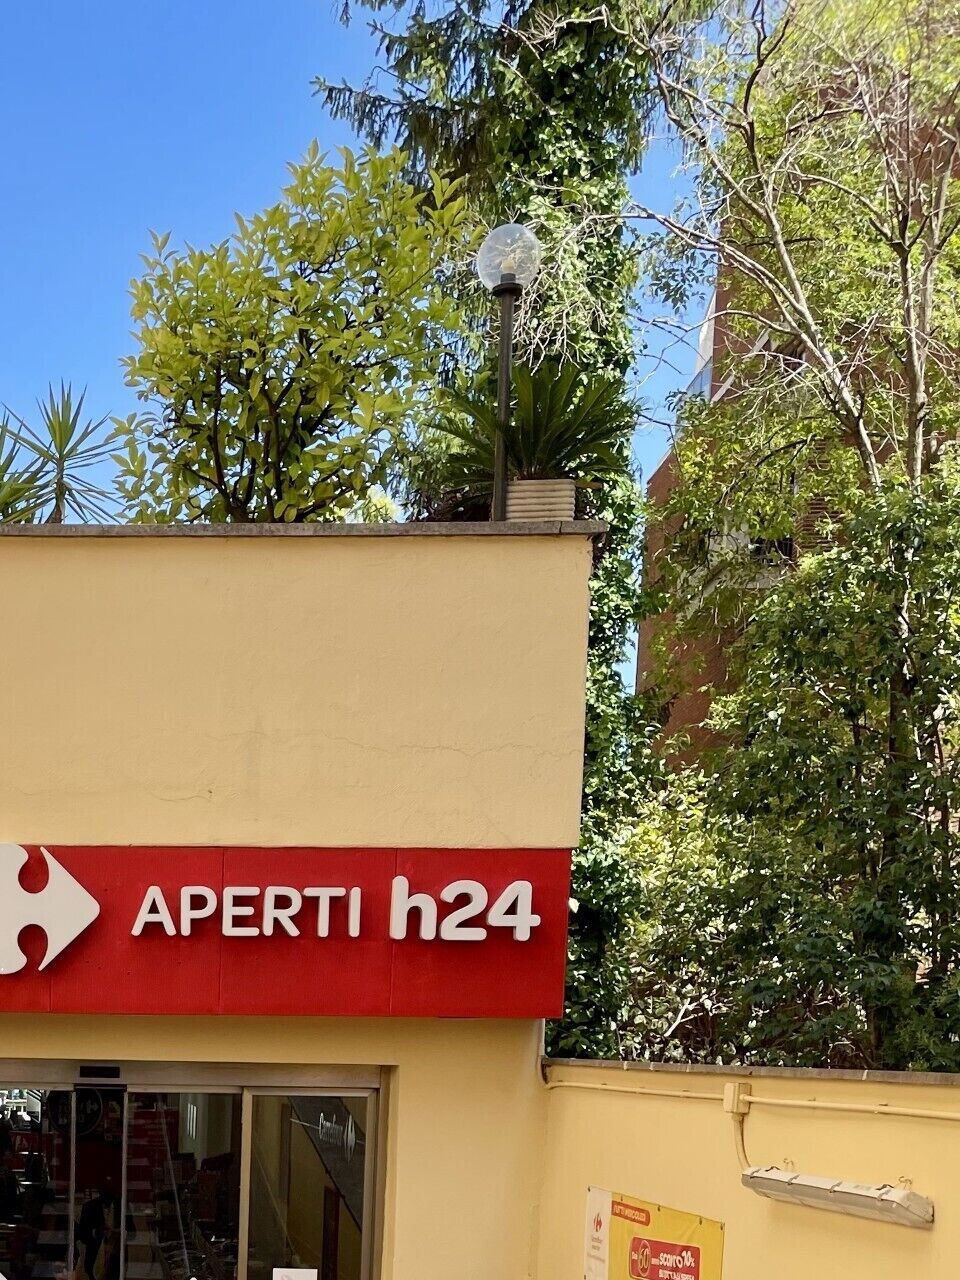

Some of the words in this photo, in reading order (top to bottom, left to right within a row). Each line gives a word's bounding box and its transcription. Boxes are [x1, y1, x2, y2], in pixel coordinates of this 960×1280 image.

[131, 885, 362, 938] APERTI
[389, 875, 541, 943] h24
[659, 1252, 683, 1268] SCONTO
